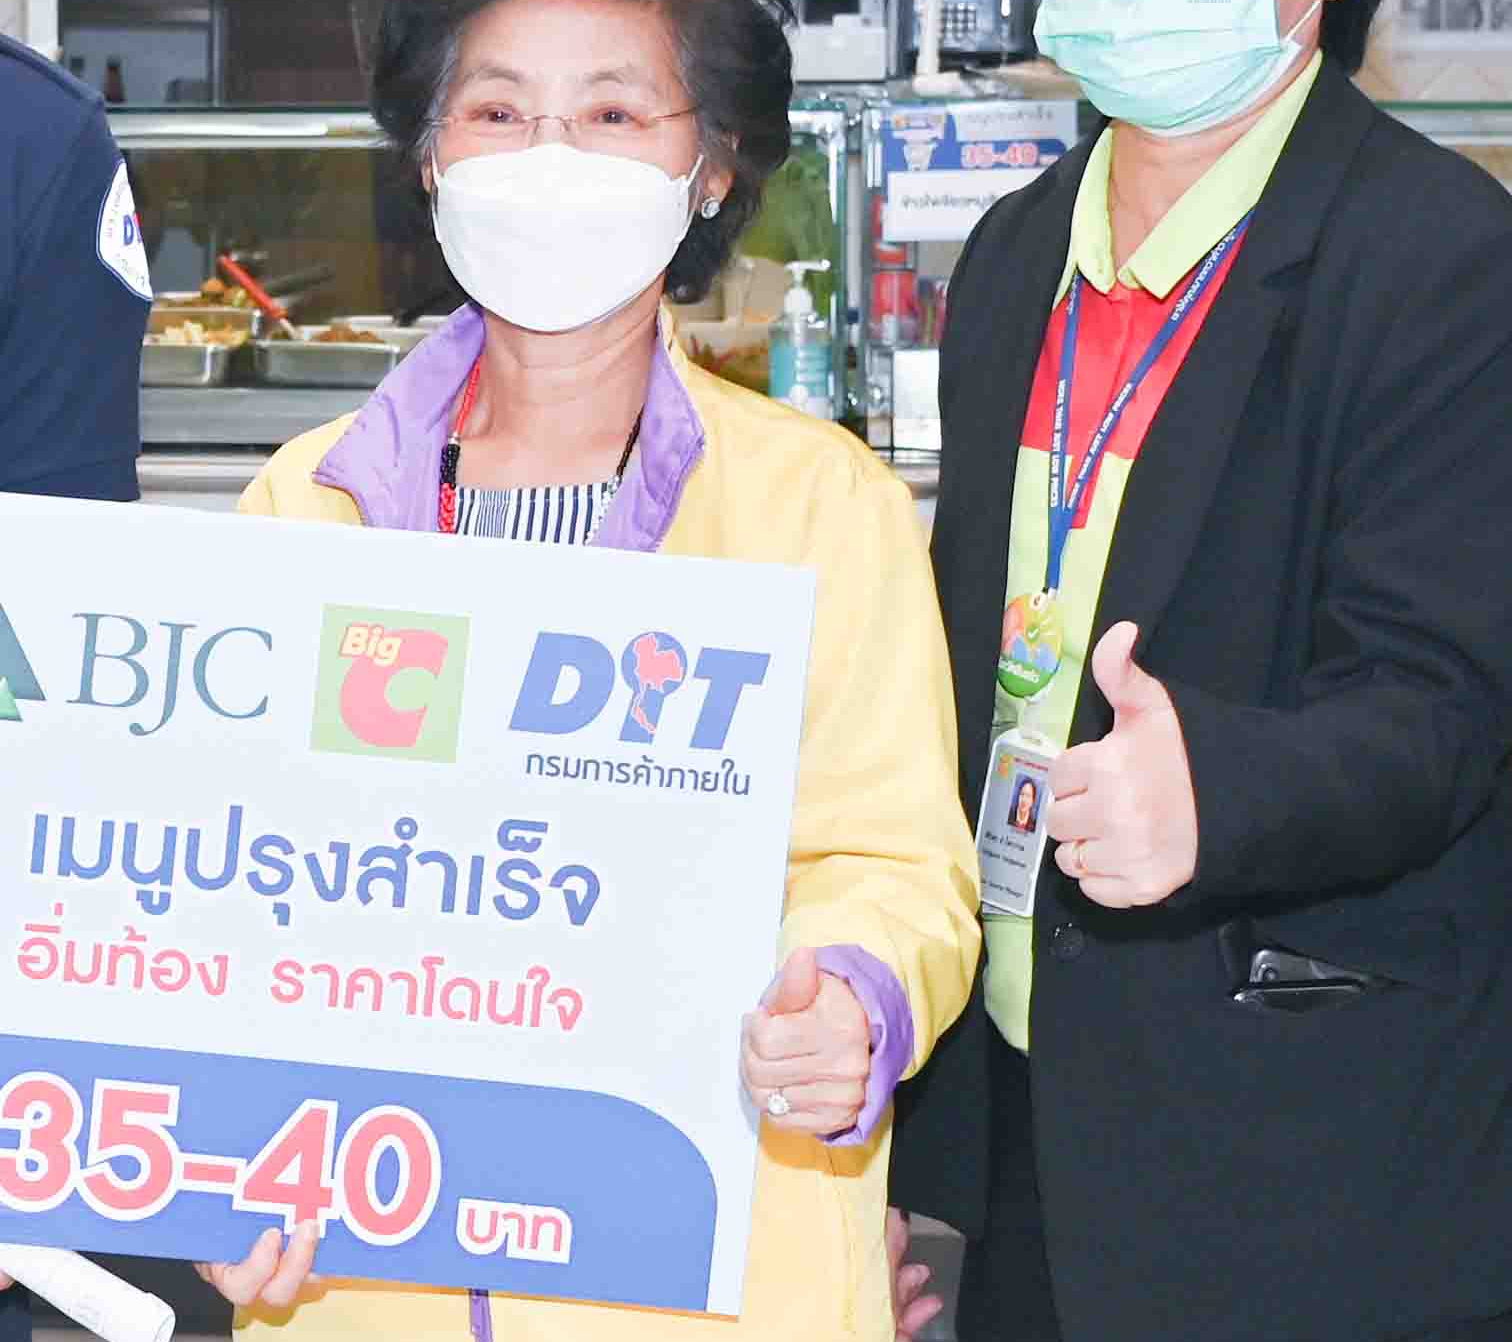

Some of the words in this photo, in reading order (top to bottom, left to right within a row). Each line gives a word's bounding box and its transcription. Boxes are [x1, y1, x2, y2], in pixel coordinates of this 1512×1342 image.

[66, 613, 274, 737] BJC
[339, 628, 449, 749] C
[340, 623, 402, 667] Big
[525, 751, 751, 796] กรมการค้าภายใน
[29, 805, 600, 927] เมนูปรุงสำเร็จ
[18, 903, 229, 997] อิ่มท้อง
[270, 955, 583, 1031] ราคาโดนใจ
[464, 1206, 562, 1252] บาท
